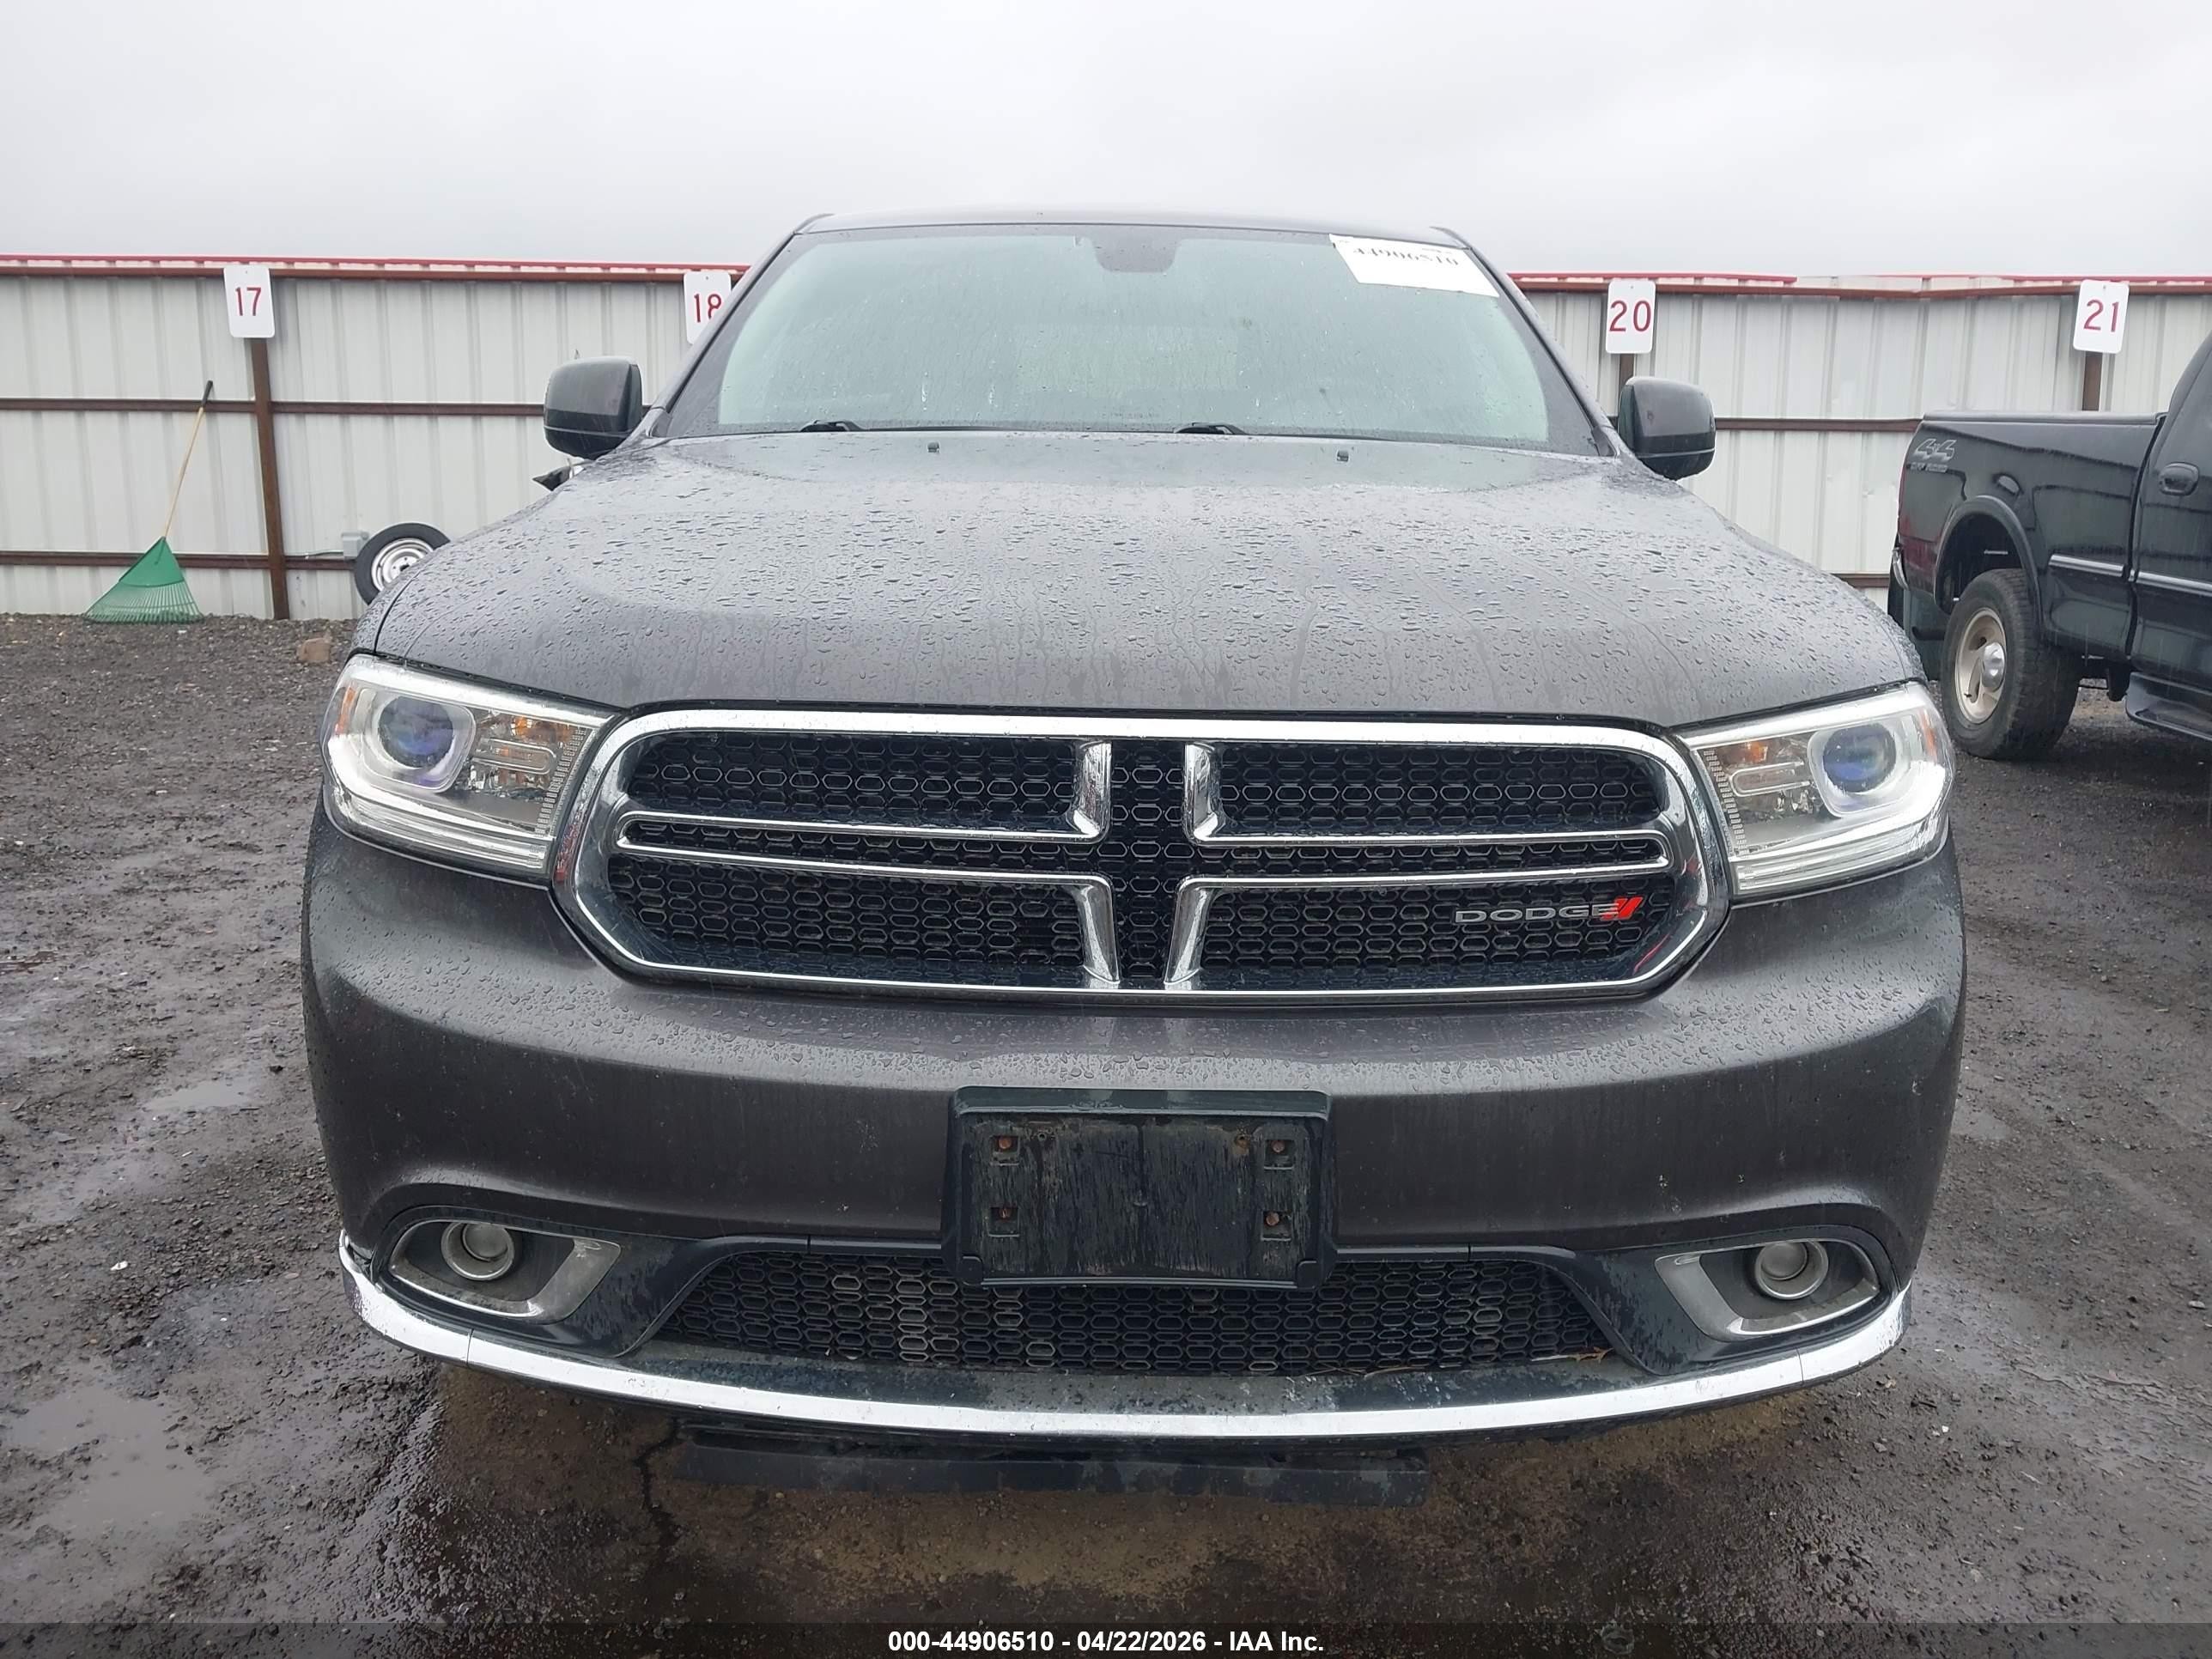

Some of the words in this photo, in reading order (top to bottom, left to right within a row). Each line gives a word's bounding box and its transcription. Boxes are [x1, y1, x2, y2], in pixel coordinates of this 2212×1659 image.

[235, 287, 262, 316] 17
[694, 293, 722, 323] 18
[1609, 300, 1651, 332] 20
[2083, 299, 2119, 332] 21
[1913, 438, 1957, 461] 4x4
[1455, 902, 1620, 923] DODGE
